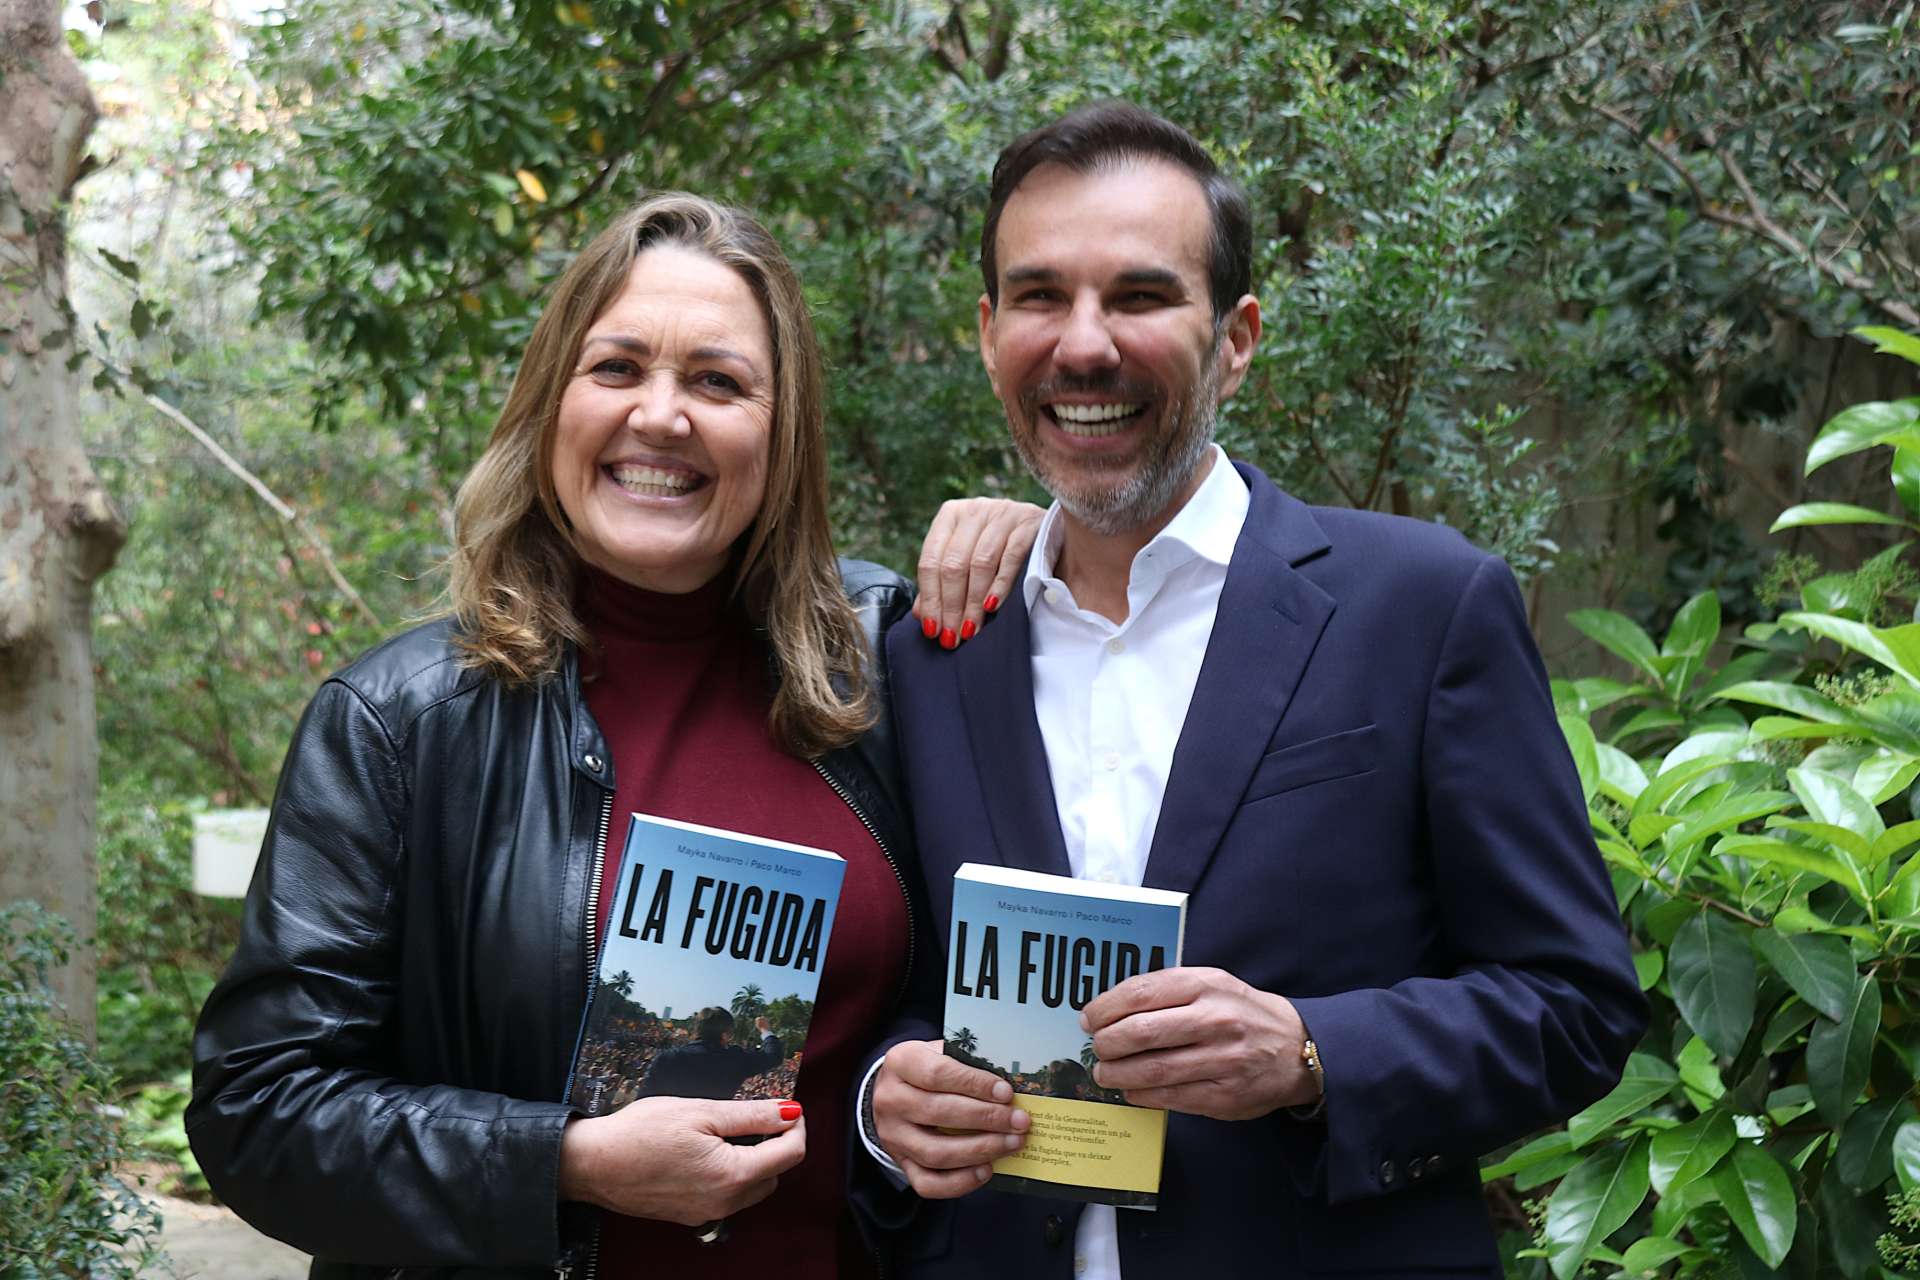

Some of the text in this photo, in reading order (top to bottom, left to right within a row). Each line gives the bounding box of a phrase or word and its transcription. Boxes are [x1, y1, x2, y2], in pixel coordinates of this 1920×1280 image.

[678, 844, 706, 858] Mayka
[709, 851, 744, 866] Navarro
[751, 859, 772, 871] Paco
[774, 864, 802, 877] Marco
[619, 863, 674, 944] LA
[680, 875, 826, 973] FUGIDA
[998, 900, 1028, 913] Mayka
[1030, 905, 1068, 918] Navarro
[1076, 911, 1100, 921] Paco
[1102, 914, 1133, 926] Marco
[953, 920, 999, 1001] LA
